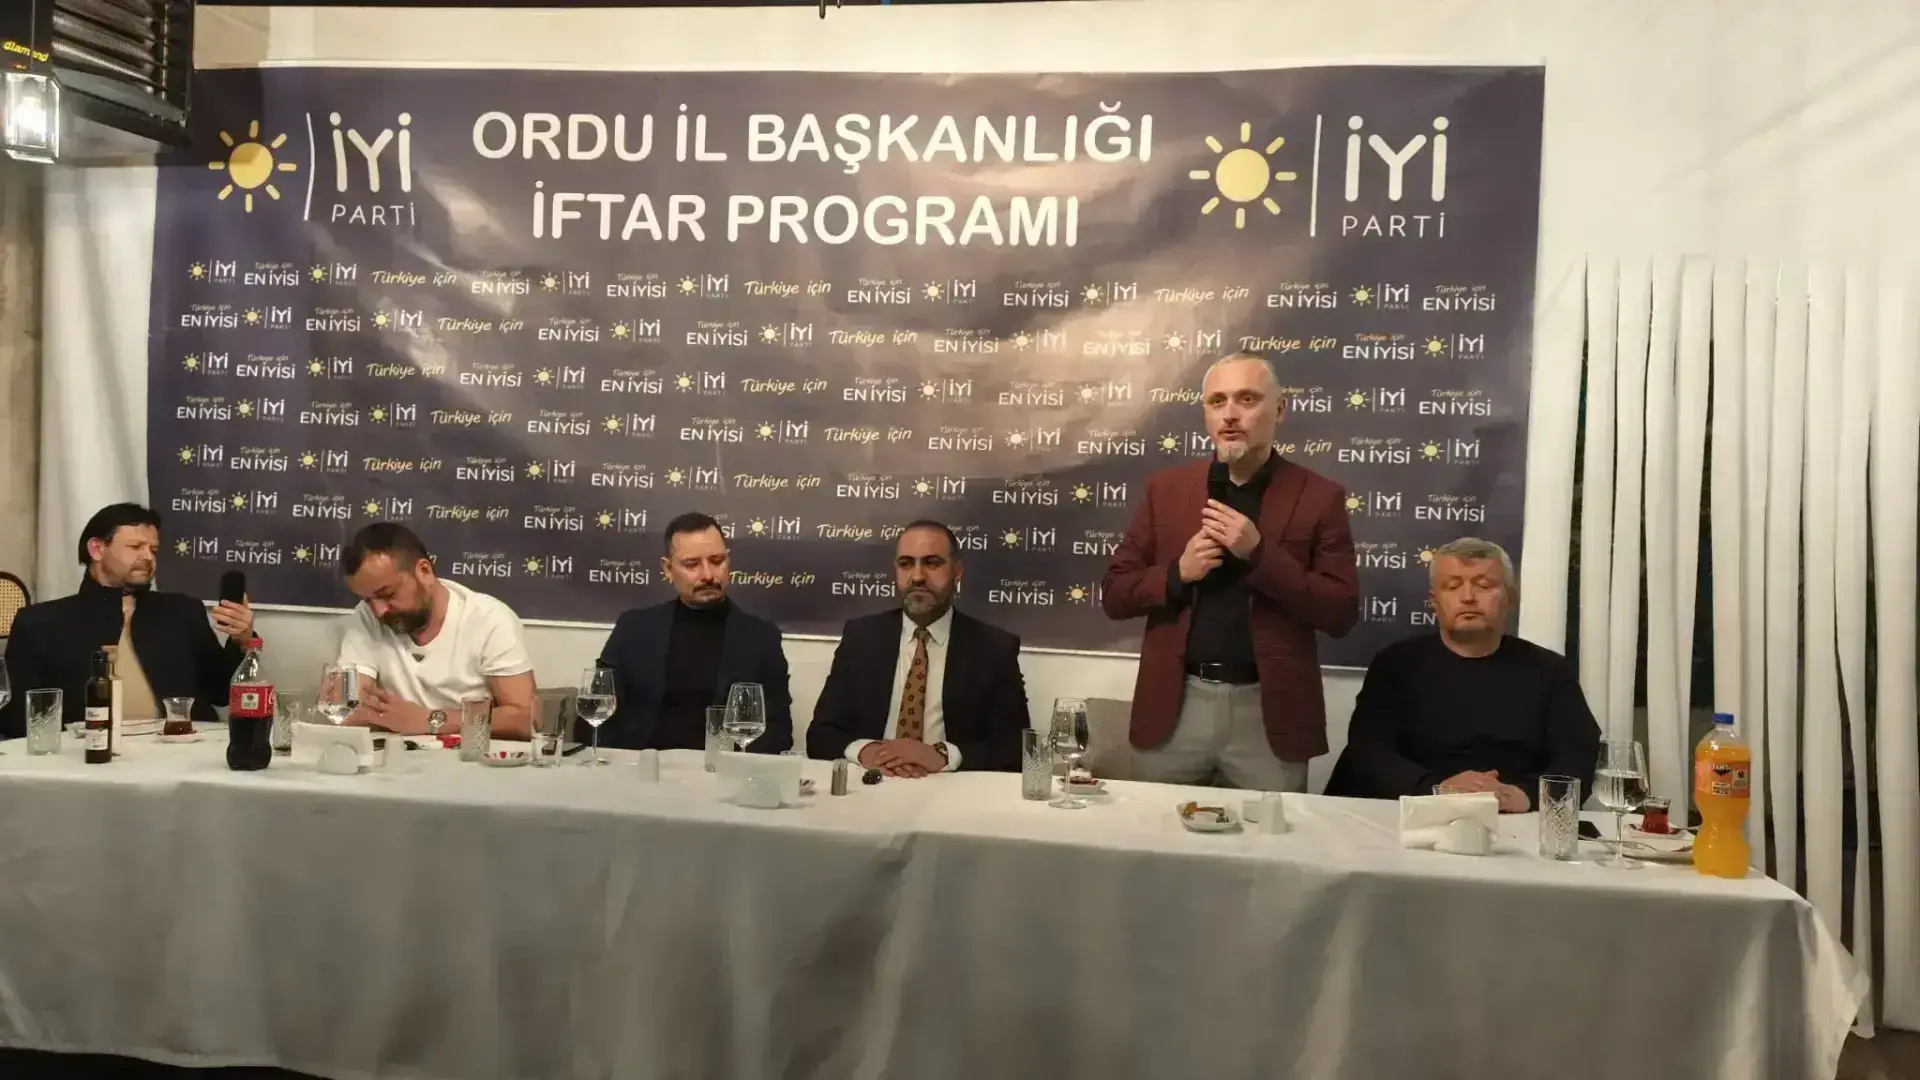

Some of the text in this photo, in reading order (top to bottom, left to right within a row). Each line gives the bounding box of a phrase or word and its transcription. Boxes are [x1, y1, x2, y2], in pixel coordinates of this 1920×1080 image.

[4, 41, 49, 61] diamnd
[473, 101, 1153, 174] ORDU İL BAŞKANLIĞI
[330, 112, 412, 193] İYİ
[1345, 115, 1449, 202] İYİ
[331, 202, 416, 226] PARTİ
[533, 180, 1079, 247] İFTAR PROGRAMI
[1342, 212, 1446, 238] PARTİ
[215, 260, 236, 277] İYİ
[336, 263, 357, 279] İYİ
[244, 269, 299, 286] EN İYİSİ
[372, 271, 457, 287] Türkiye için
[708, 274, 728, 292] İYİ
[744, 280, 831, 297] Türkiye için
[1222, 286, 1249, 302] için
[1385, 284, 1409, 302] İYİ
[1004, 290, 1069, 307] EN İYİSİ
[1267, 290, 1337, 308] EN İYİSİ
[1423, 292, 1495, 311] EN İYİSİ
[181, 312, 238, 328] EN İYİSİ
[272, 306, 291, 323] İYİ
[306, 315, 360, 332] EN İYİSİ
[437, 317, 523, 334] Türkiye için
[640, 319, 660, 336] İYİ
[538, 326, 599, 342] EN İYİSİ
[828, 330, 917, 347] Türkiye için
[1239, 336, 1337, 354] Türkiye için
[1343, 342, 1414, 360] EN İYİSİ
[1459, 334, 1484, 352] İYİ
[208, 352, 228, 369] İYİ
[334, 357, 352, 373] İYİ
[236, 363, 295, 379] EN İYİSİ
[366, 363, 445, 380] Türkiye için
[563, 366, 585, 383] İYİ
[601, 376, 663, 394] EN İYİSİ
[704, 372, 725, 389] İYİ
[741, 378, 827, 395] Türkiye için
[1292, 394, 1331, 412] İYİSİ
[1381, 388, 1405, 406] İYİ
[177, 403, 231, 420] EN İYİSİ
[264, 398, 284, 415] İYİ
[396, 403, 416, 420] İYİ
[1419, 397, 1491, 416] EN İYİSİ
[300, 408, 359, 426] EN İYİSİ
[430, 410, 512, 427] Türkiye için
[633, 414, 655, 431] İYİ
[680, 425, 743, 443] EN İYİSİ
[786, 420, 808, 438] İYİ
[824, 427, 912, 444] Türkiye için
[203, 444, 223, 461] İYİ
[1304, 439, 1332, 456] için
[1338, 446, 1410, 464] EN İYİSİ
[1455, 439, 1480, 458] İYİ
[231, 454, 288, 471] EN İYİSİ
[327, 450, 348, 467] İYİ
[363, 457, 441, 474] Türkiye için
[456, 464, 514, 482] EN İYİSİ
[554, 460, 575, 477] İYİ
[696, 467, 717, 484] İYİ
[734, 474, 820, 491] Türkiye için
[944, 476, 965, 494] İYİ
[1104, 482, 1126, 500] İYİ
[172, 497, 225, 513] EN İYİSİ
[257, 491, 277, 508] İYİ
[993, 489, 1058, 505] EN İYİSİ
[1376, 492, 1401, 510] İYİ
[293, 502, 351, 519] EN İYİSİ
[392, 498, 412, 514] İYİ
[427, 505, 509, 522] Türkiye için
[1415, 503, 1485, 522] EN İYİSİ
[524, 513, 583, 531] EN İYİSİ
[625, 509, 646, 526] İYİ
[778, 516, 800, 534] İYİ
[816, 524, 872, 541] Türkiye
[1033, 527, 1055, 545] İYİ
[199, 537, 218, 554] İYİ
[956, 533, 987, 550] YİSİ
[1073, 542, 1098, 555] EN
[226, 547, 281, 564] EN İYİSİ
[320, 543, 340, 560] İYİ
[1366, 550, 1406, 568] İYİSİ
[452, 560, 511, 577] EN İYİSİ
[552, 556, 572, 573] İYİ
[589, 568, 649, 585] EN İYİSİ
[729, 571, 815, 588] Türkiye için
[832, 580, 895, 597] EN İYİSİ
[989, 588, 1053, 605] EN İYİSİ
[1372, 596, 1397, 615] İYİ
